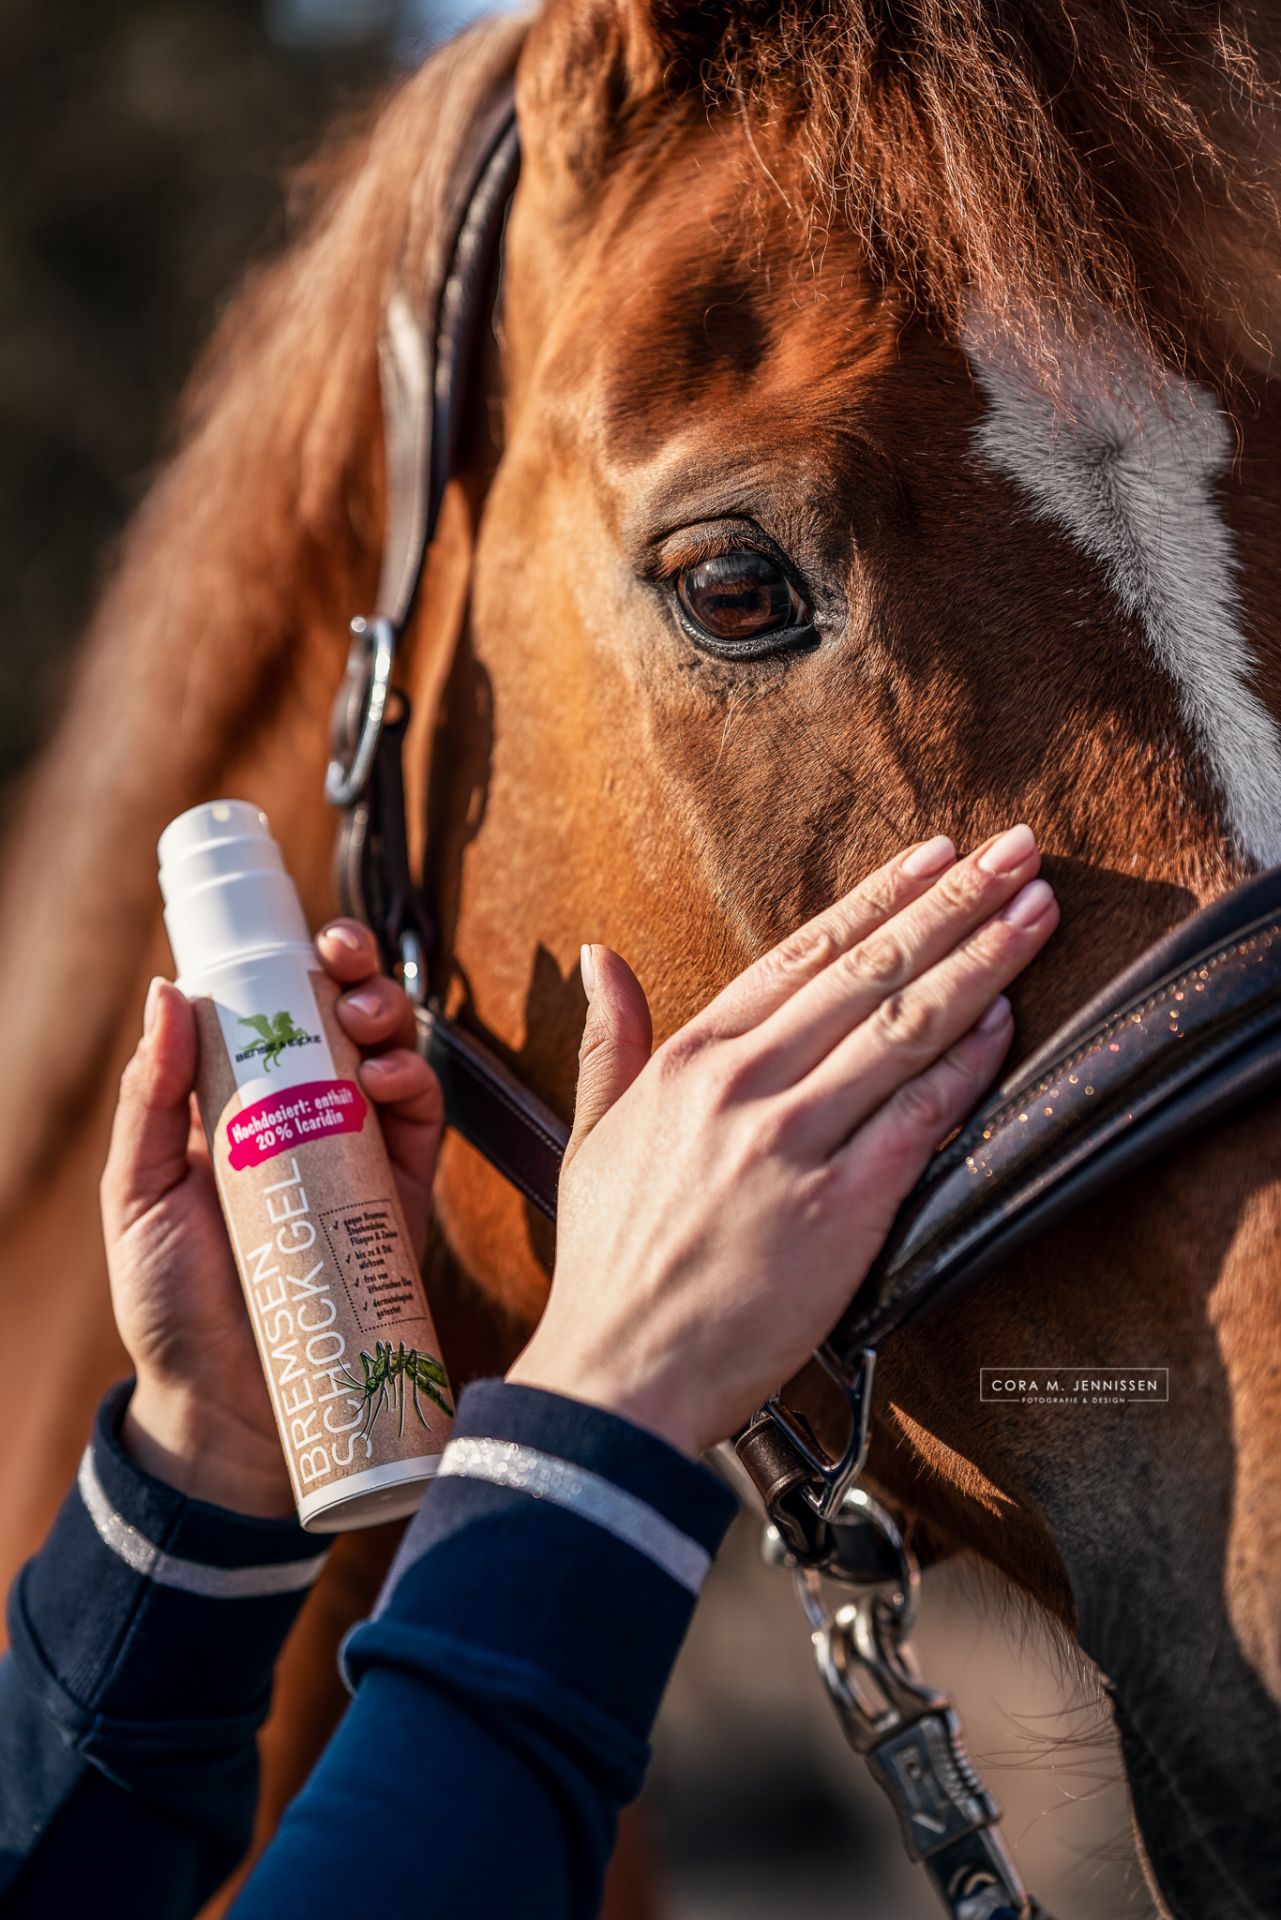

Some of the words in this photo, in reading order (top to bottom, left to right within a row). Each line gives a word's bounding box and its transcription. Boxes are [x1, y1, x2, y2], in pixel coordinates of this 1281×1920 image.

[231, 1099, 312, 1145] Hochdosiert:
[314, 1088, 354, 1110] enthält
[294, 1109, 344, 1134] Icaridin
[263, 1157, 317, 1255] GEL
[354, 1250, 367, 1261] bis
[367, 1248, 376, 1257] zu
[359, 1259, 385, 1270] wirksam
[363, 1274, 377, 1284] frei
[377, 1272, 389, 1281] von
[376, 1306, 402, 1320] getestet
[246, 1242, 331, 1485] BREMSEN
[286, 1260, 372, 1467] SCHOCK
